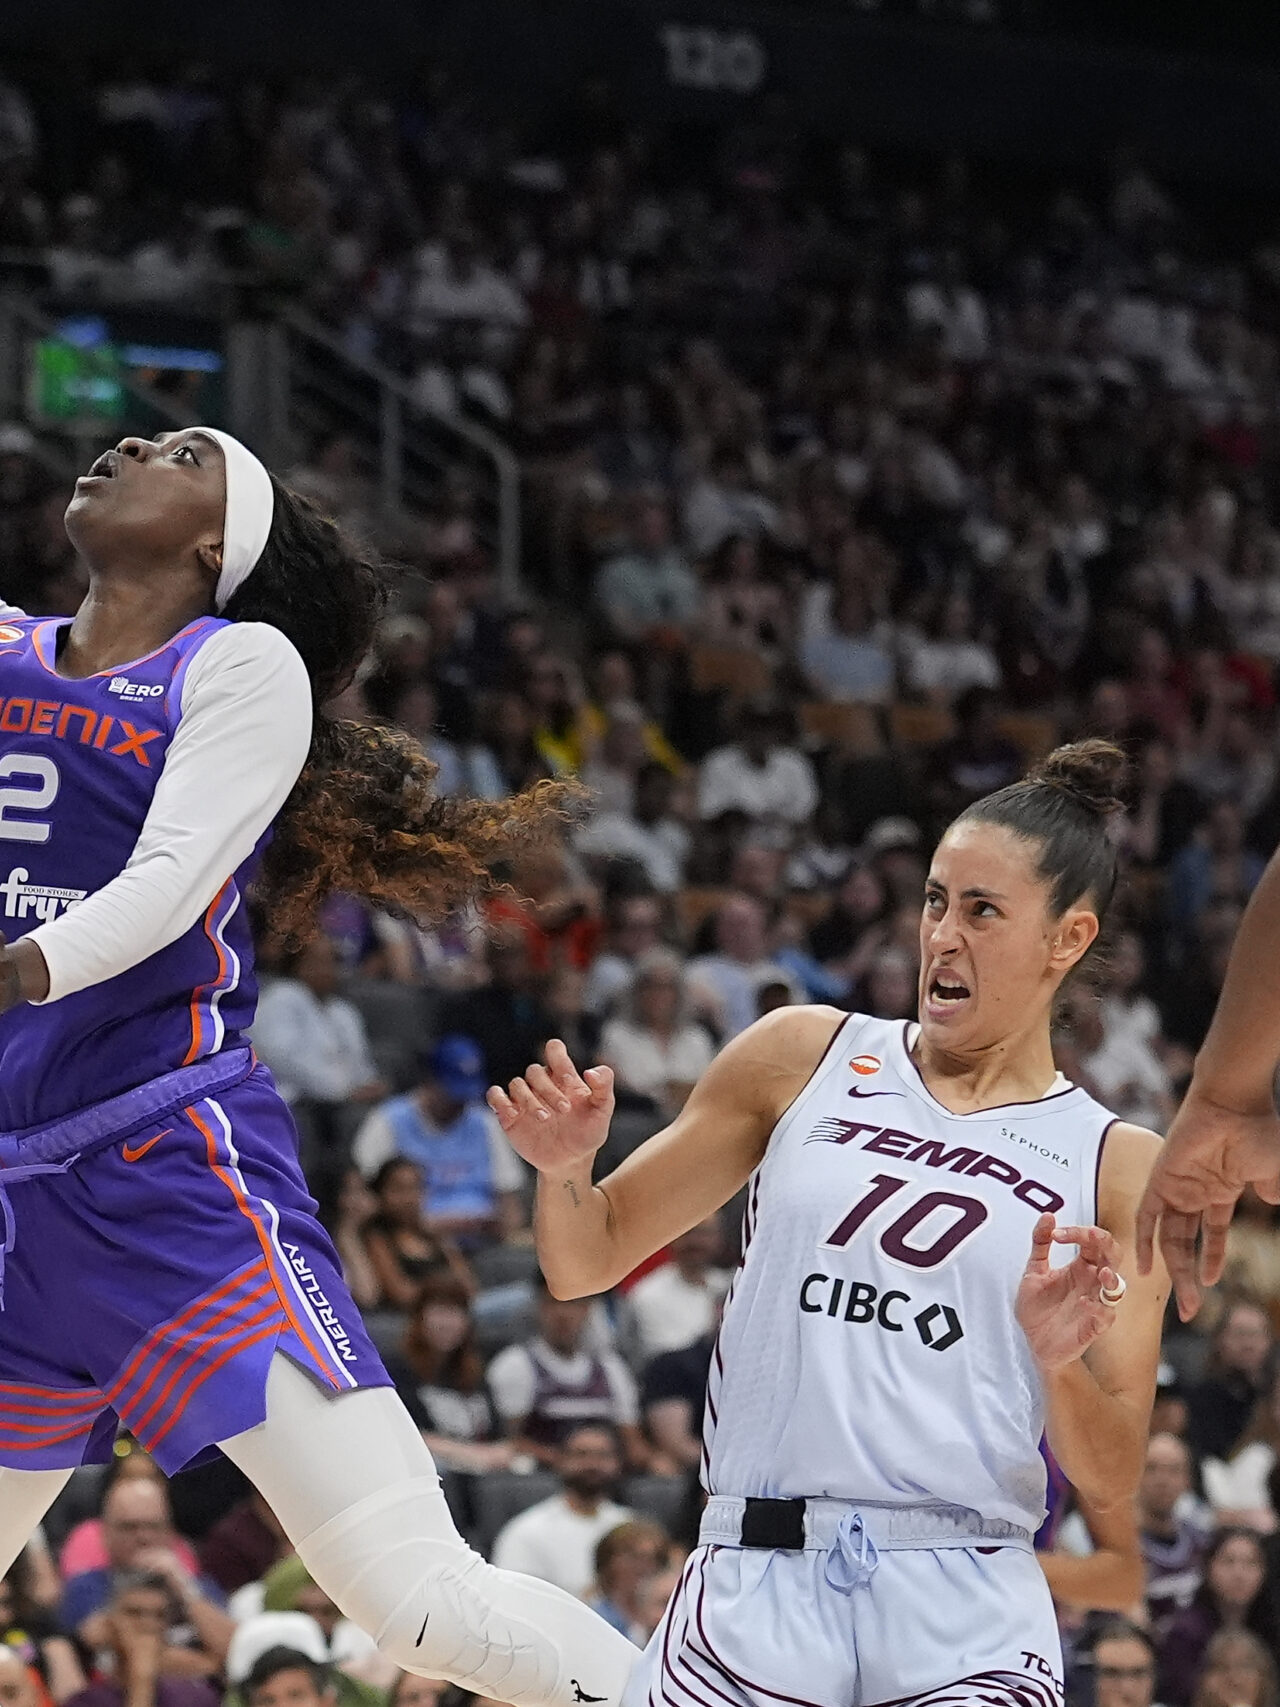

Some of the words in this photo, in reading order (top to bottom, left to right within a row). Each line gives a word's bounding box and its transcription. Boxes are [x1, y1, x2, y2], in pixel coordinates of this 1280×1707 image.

[806, 1117, 1066, 1215] TEMPO
[1000, 1127, 1071, 1168] SEPHORA
[824, 1172, 990, 1270] 10
[281, 1241, 357, 1361] MERCURY
[799, 1272, 912, 1333] CIBC
